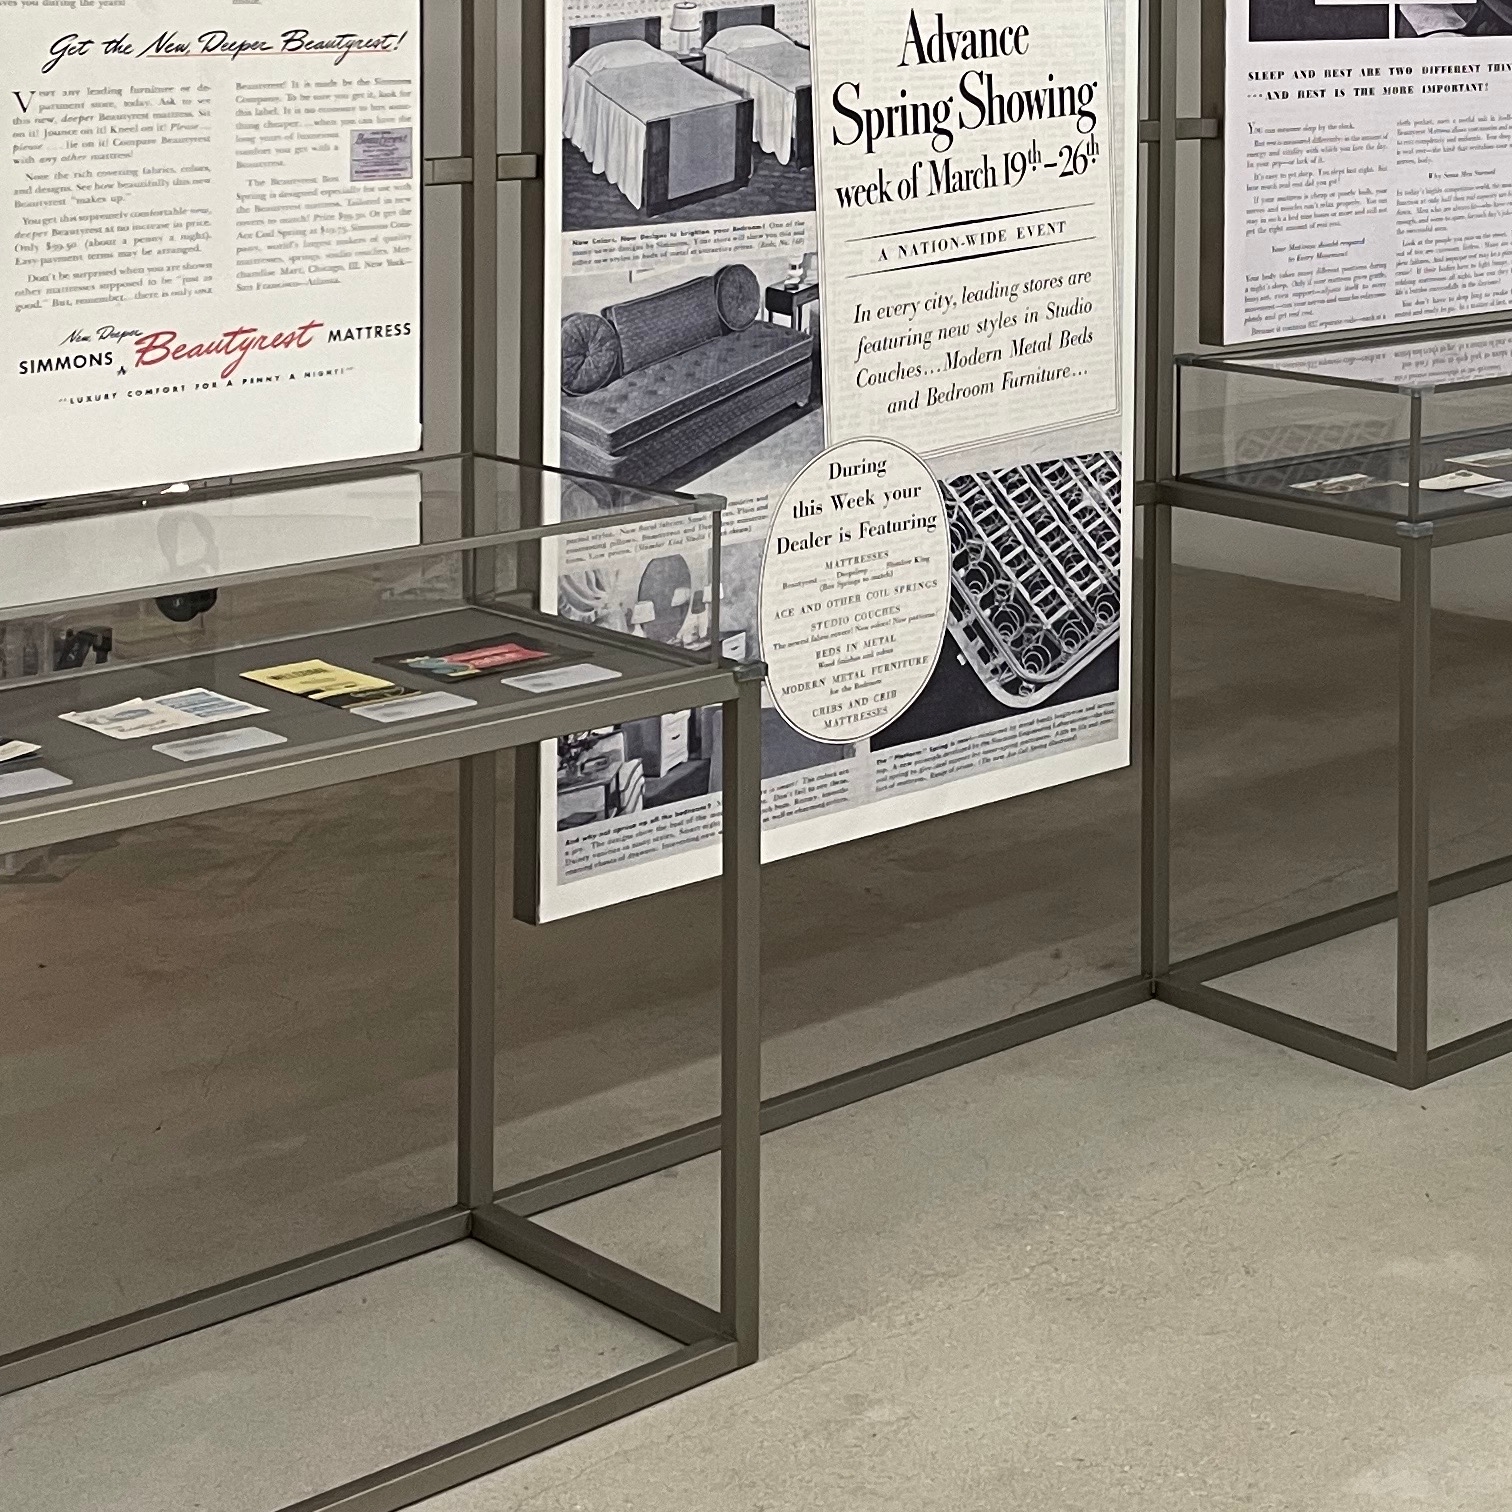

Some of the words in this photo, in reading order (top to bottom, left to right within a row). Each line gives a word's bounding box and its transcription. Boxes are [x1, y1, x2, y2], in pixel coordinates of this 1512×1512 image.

[41, 33, 94, 74] Get
[101, 33, 134, 57] the
[198, 30, 273, 61] Deeper
[280, 30, 408, 66] Beautyrest!
[897, 8, 1029, 68] Advance
[1248, 71, 1285, 81] SLEEP
[1293, 69, 1316, 79] AND
[1324, 68, 1352, 78] REST
[1359, 67, 1381, 78] ARE
[1388, 66, 1413, 76] TWO
[1422, 64, 1481, 75] DIFFERENT
[1297, 89, 1327, 99] REST
[1334, 88, 1346, 98] IS
[1353, 87, 1376, 97] THE
[1382, 85, 1414, 96] MORE
[1422, 82, 1489, 94] IMPORTANT!
[832, 81, 954, 154] Spring
[959, 69, 1098, 134] Showing
[835, 168, 893, 208] week
[897, 167, 923, 200] of
[927, 153, 996, 197] March
[877, 248, 889, 261] A
[895, 232, 1009, 258] NATION-WIDE
[1016, 221, 1067, 242] EVENT
[852, 304, 873, 324] In
[876, 299, 919, 324] every
[924, 290, 957, 316] city,
[960, 279, 1020, 309] leading
[1023, 275, 1063, 299] stores
[1067, 271, 1092, 289] are
[96, 325, 144, 344] Deeper
[855, 328, 934, 362] featuring
[938, 322, 970, 339] new
[976, 312, 1017, 335] styles
[1024, 310, 1039, 326] in
[1046, 298, 1092, 321] Studio
[1009, 334, 1052, 357] Metal
[1058, 328, 1093, 347] Beds
[18, 352, 114, 376] SIMMONS
[134, 319, 324, 380] Beautyrest
[327, 322, 412, 344] MATTRESS
[127, 385, 186, 398] COMFORT
[195, 382, 218, 391] FOR
[242, 375, 281, 386] PENNY
[289, 373, 297, 381] A
[887, 392, 919, 415] and
[926, 380, 994, 410] Bedroom
[1001, 366, 1087, 393] Furniture...
[828, 458, 888, 484] During
[792, 499, 824, 522] this
[831, 489, 875, 513] Week
[882, 486, 923, 510] your
[777, 532, 832, 555] Dealer
[840, 526, 851, 543] is
[858, 514, 938, 542] Featuring
[825, 550, 889, 569] MATTRESSES
[774, 608, 795, 621] ACE
[800, 602, 822, 614] AND
[826, 594, 862, 608] OTHER
[866, 588, 890, 601] COIL
[894, 579, 938, 594] SPRINGS
[811, 616, 850, 632] STUDIO
[854, 606, 901, 622] COUCHES
[815, 646, 841, 660] BEDS
[846, 643, 858, 653] IN
[864, 634, 897, 648] METAL
[781, 678, 826, 696] MODERN
[832, 669, 866, 684] METAL
[871, 655, 929, 675] FURNITURE
[812, 704, 843, 718] CRIBS
[850, 697, 869, 709] AND
[873, 689, 897, 703] CRIB
[824, 705, 888, 729] MATTRESSES
